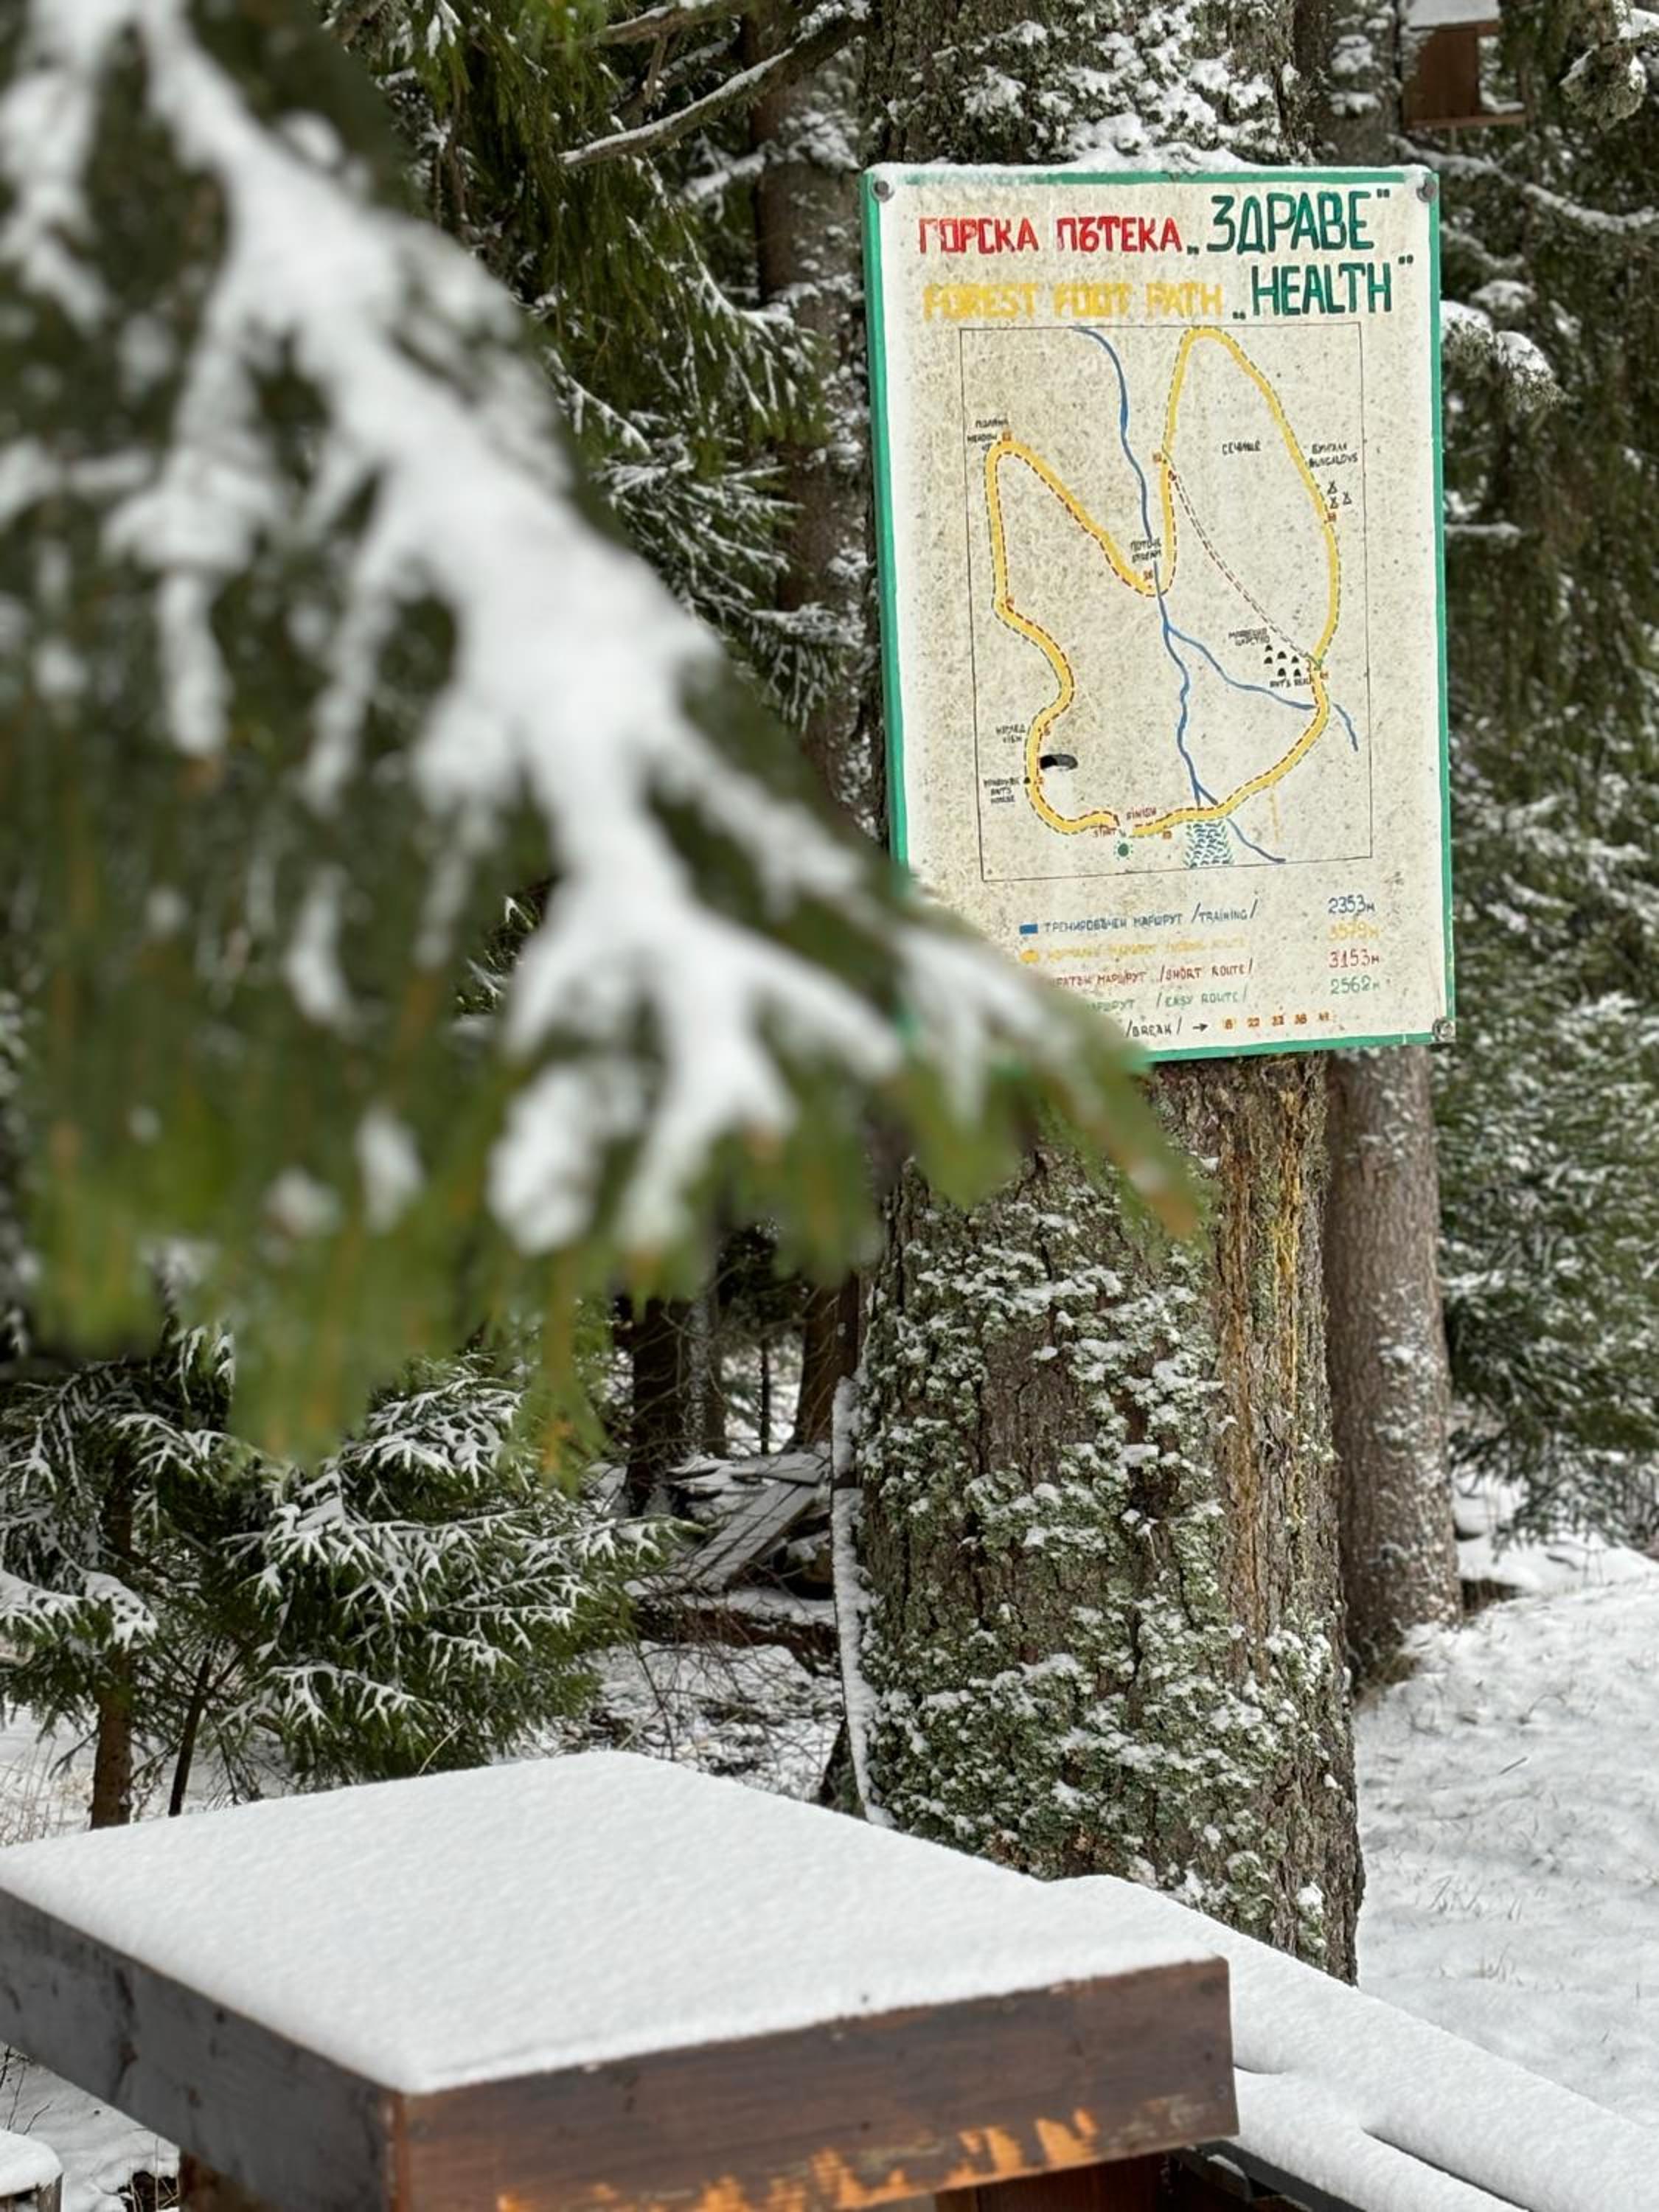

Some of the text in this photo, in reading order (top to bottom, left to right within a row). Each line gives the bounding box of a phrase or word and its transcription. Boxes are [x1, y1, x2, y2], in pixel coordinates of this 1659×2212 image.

[919, 216, 1040, 254] ГОРСКА
[1056, 215, 1183, 253] ПЪТЕКА
[923, 282, 1039, 321] FOREST
[1146, 280, 1223, 319] PATH
